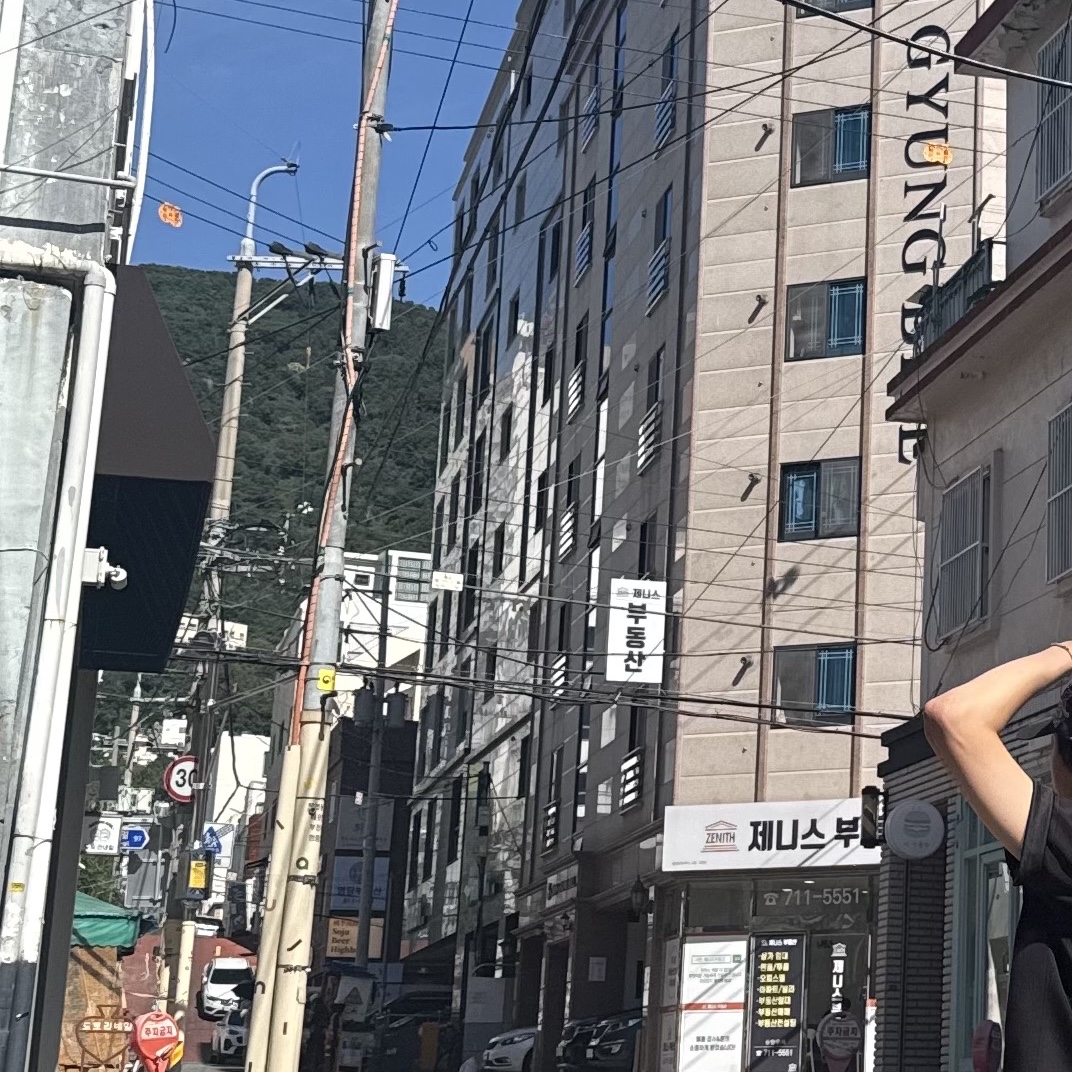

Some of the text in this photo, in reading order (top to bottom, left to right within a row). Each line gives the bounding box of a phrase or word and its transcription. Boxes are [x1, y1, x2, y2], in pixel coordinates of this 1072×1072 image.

[632, 588, 661, 600] 제니스
[624, 602, 647, 673] 부동산
[705, 832, 736, 844] ZENITH
[748, 818, 826, 852] 제니스
[784, 888, 860, 906] 711-5551
